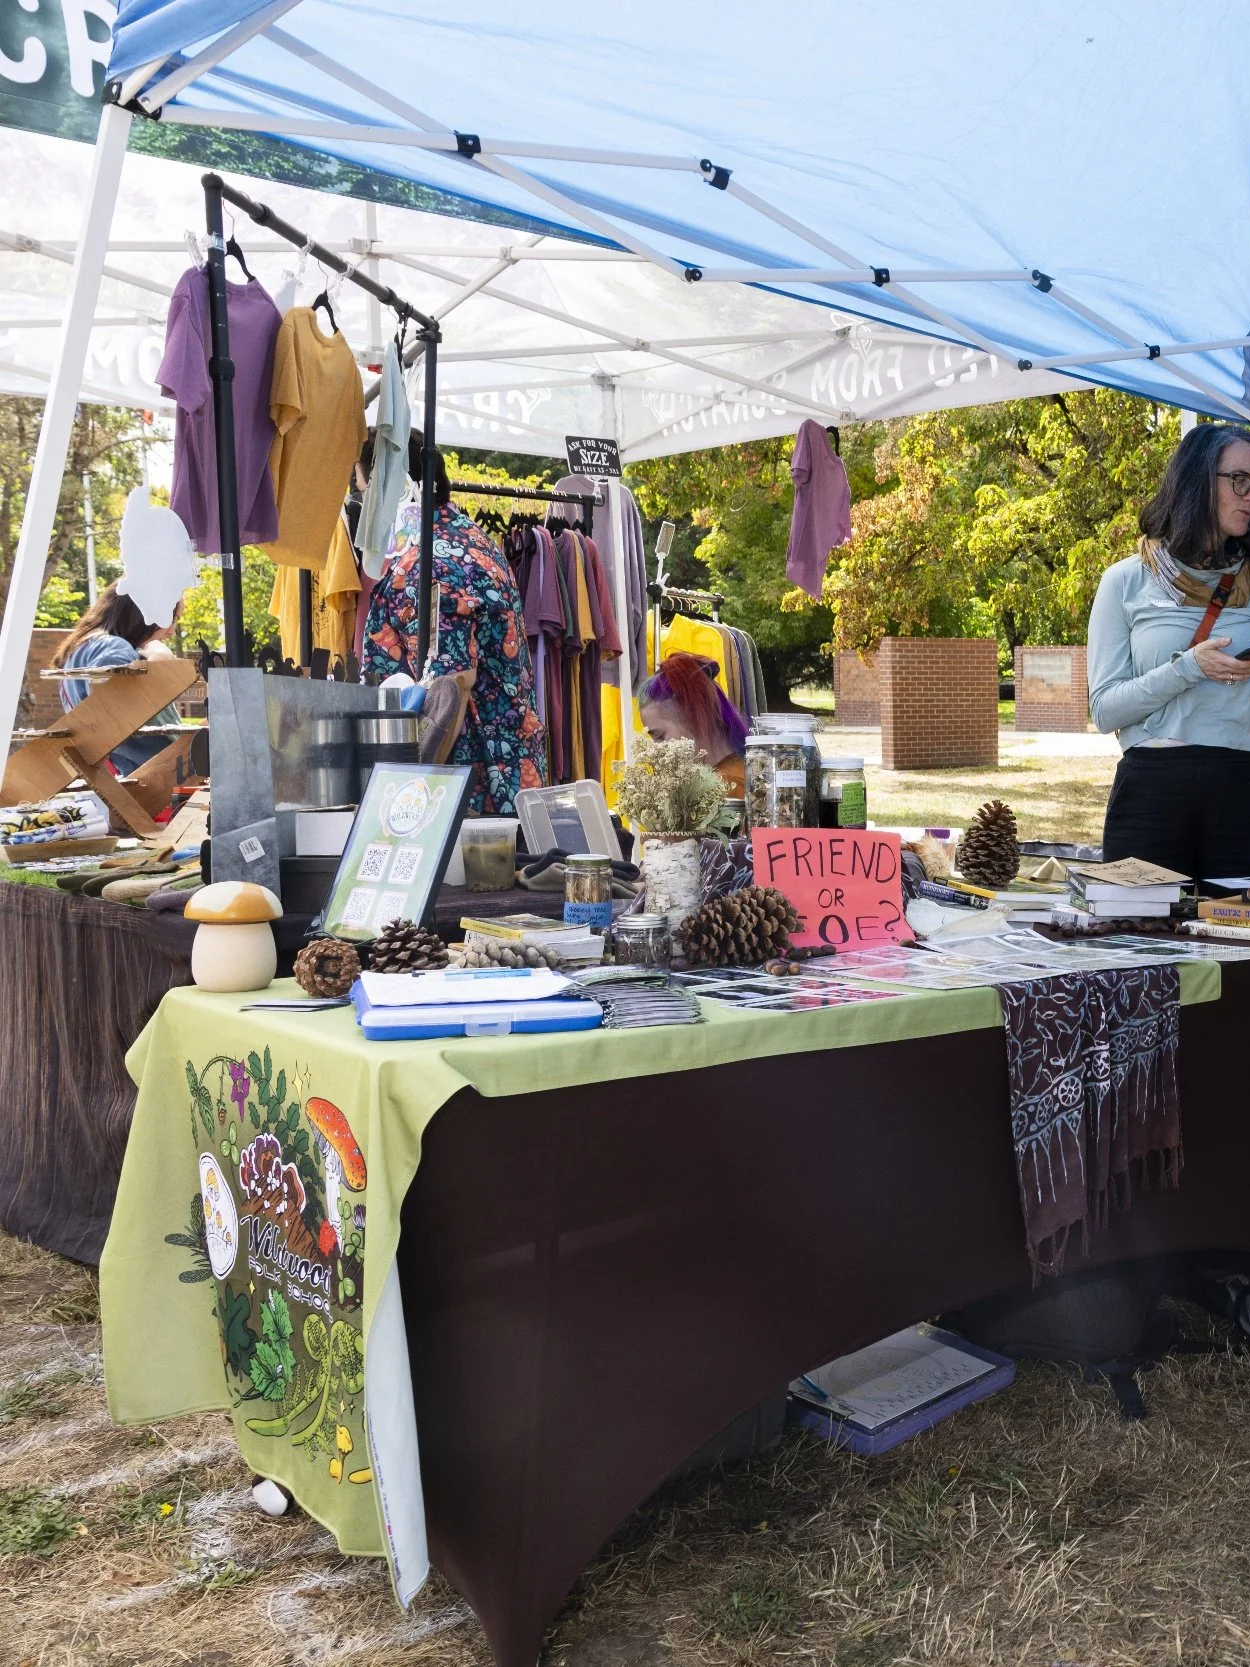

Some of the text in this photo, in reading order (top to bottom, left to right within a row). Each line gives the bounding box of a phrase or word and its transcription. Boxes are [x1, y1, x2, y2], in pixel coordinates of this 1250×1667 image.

[568, 439, 617, 456] ASK FOR YOUR
[766, 837, 897, 883] FRIEND
[818, 888, 845, 908] OR
